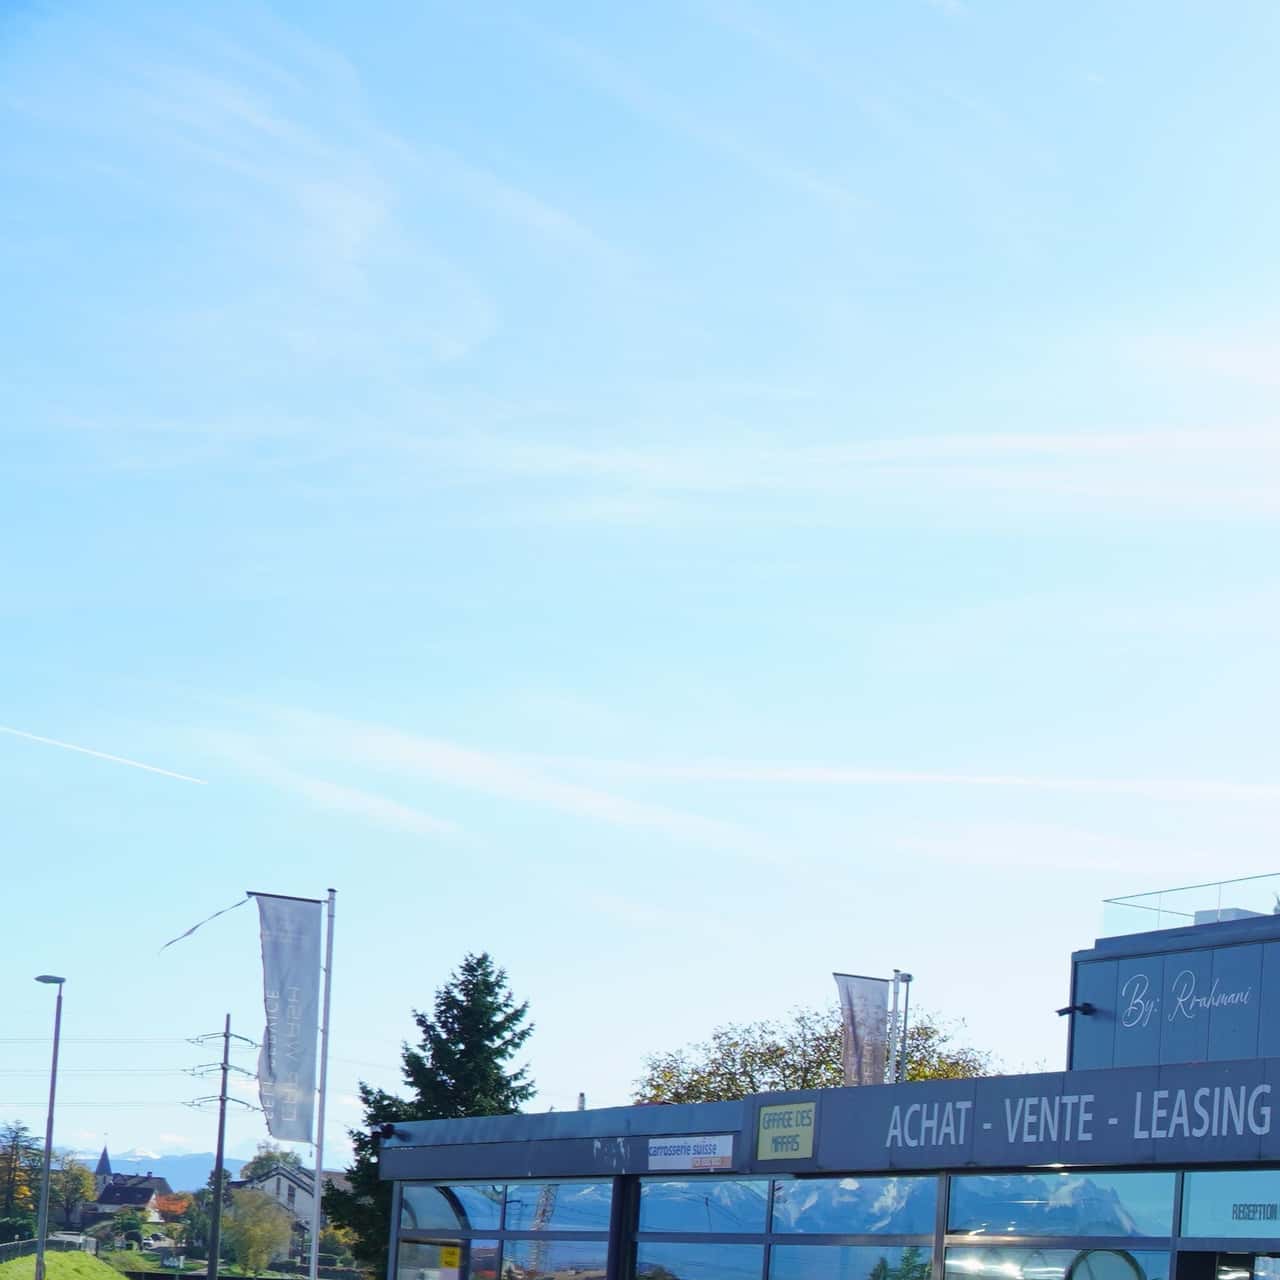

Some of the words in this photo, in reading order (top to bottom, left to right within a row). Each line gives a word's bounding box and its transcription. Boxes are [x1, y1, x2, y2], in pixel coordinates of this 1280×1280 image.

[1121, 973, 1161, 1028] By:
[1167, 969, 1252, 1022] Rrahmani
[885, 1100, 973, 1148] ACHAT
[1004, 1094, 1095, 1144] VENTE
[1133, 1084, 1272, 1140] LEASING
[692, 1142, 717, 1155] suisse
